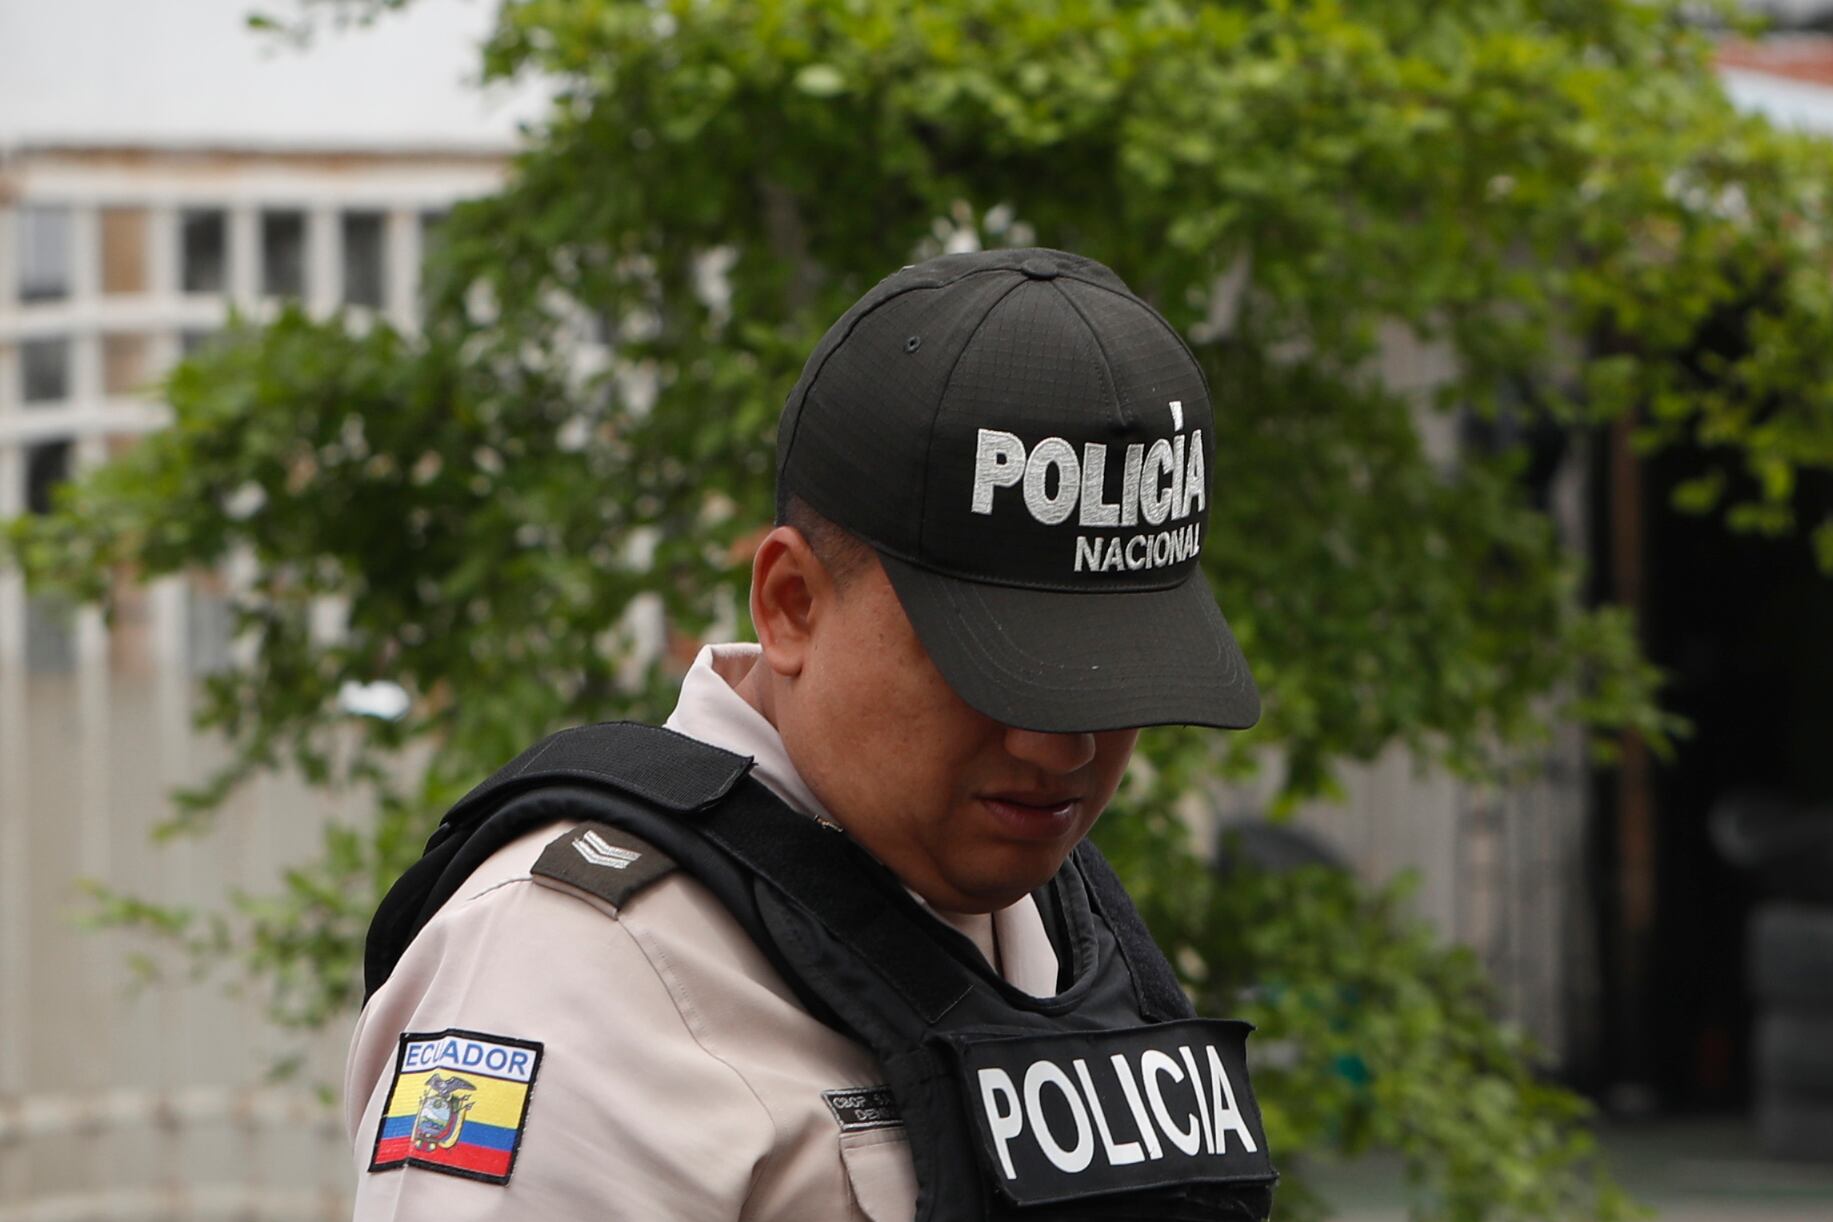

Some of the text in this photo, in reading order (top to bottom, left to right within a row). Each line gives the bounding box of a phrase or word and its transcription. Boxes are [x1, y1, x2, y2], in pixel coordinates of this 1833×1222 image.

[971, 401, 1206, 527] POLICÍA
[1073, 523, 1200, 572] NACIONAL
[405, 1039, 529, 1076] ECUADOR
[977, 1045, 1258, 1180] POLICIA
